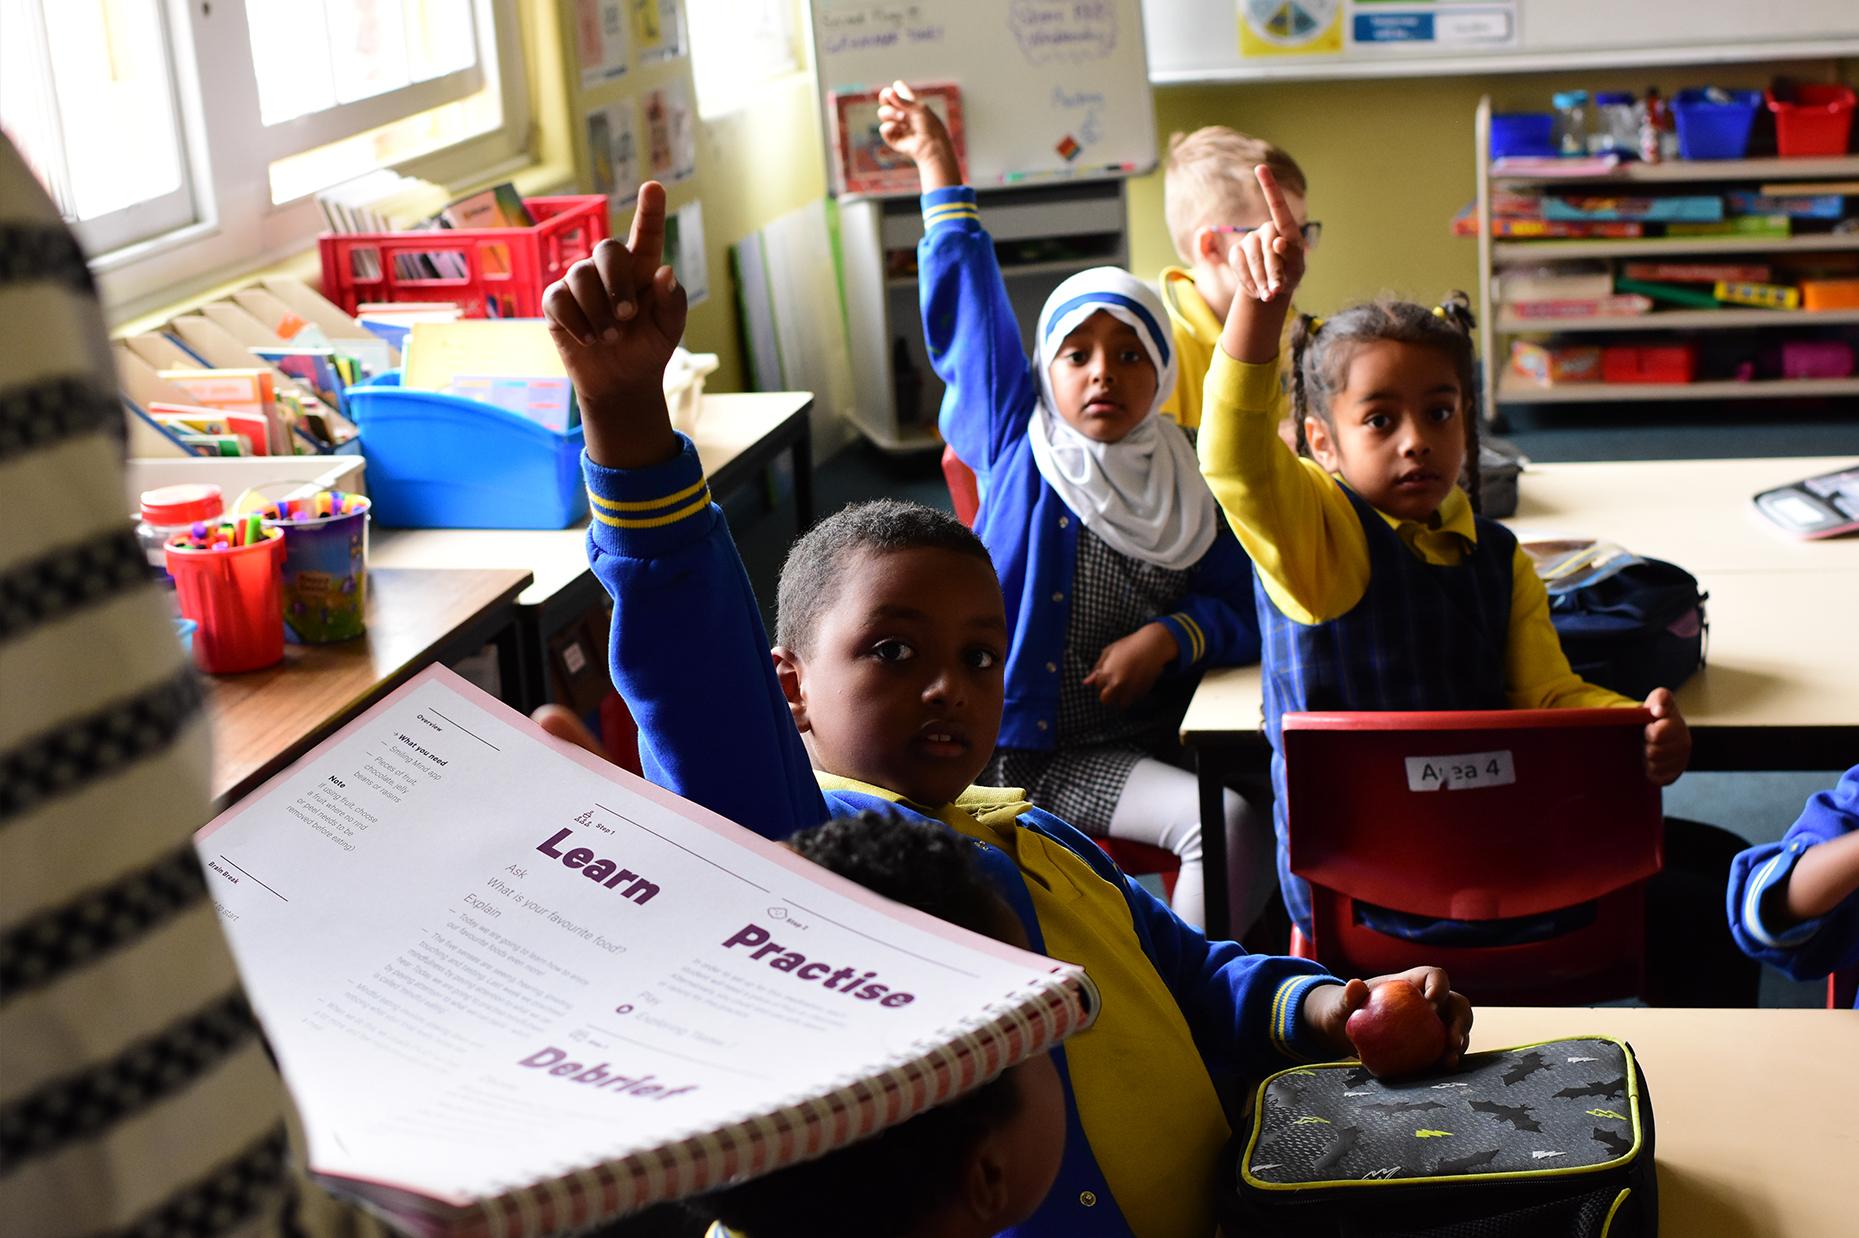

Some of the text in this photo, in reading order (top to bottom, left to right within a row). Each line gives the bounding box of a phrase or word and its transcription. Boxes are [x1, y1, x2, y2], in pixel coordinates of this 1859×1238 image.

[417, 714, 443, 732] Overview
[374, 756, 397, 773] Pieces
[389, 745, 442, 781] Smiling Mind app
[398, 734, 448, 767] What you need
[328, 775, 346, 788] Note
[1486, 759, 1500, 776] 4
[353, 771, 374, 786] beans
[379, 788, 402, 803] raisins
[392, 783, 409, 794] jelly
[302, 803, 321, 815] peel
[316, 811, 338, 826] needs
[343, 828, 354, 837] be
[312, 793, 327, 805] fruit
[325, 802, 346, 817] where
[352, 820, 369, 831] rind
[322, 787, 342, 801] using
[354, 807, 378, 824] choose
[285, 805, 356, 852] removed before eating)
[596, 824, 610, 833] Step
[208, 861, 239, 884] Brain Break
[504, 863, 529, 880] Ask
[536, 827, 660, 906] Learn
[222, 908, 240, 922] start
[464, 893, 502, 920] Explain
[487, 877, 627, 953] What is your favourite food?
[446, 922, 461, 931] our
[720, 923, 915, 1008] Practise
[517, 1046, 699, 1101] Debrief
